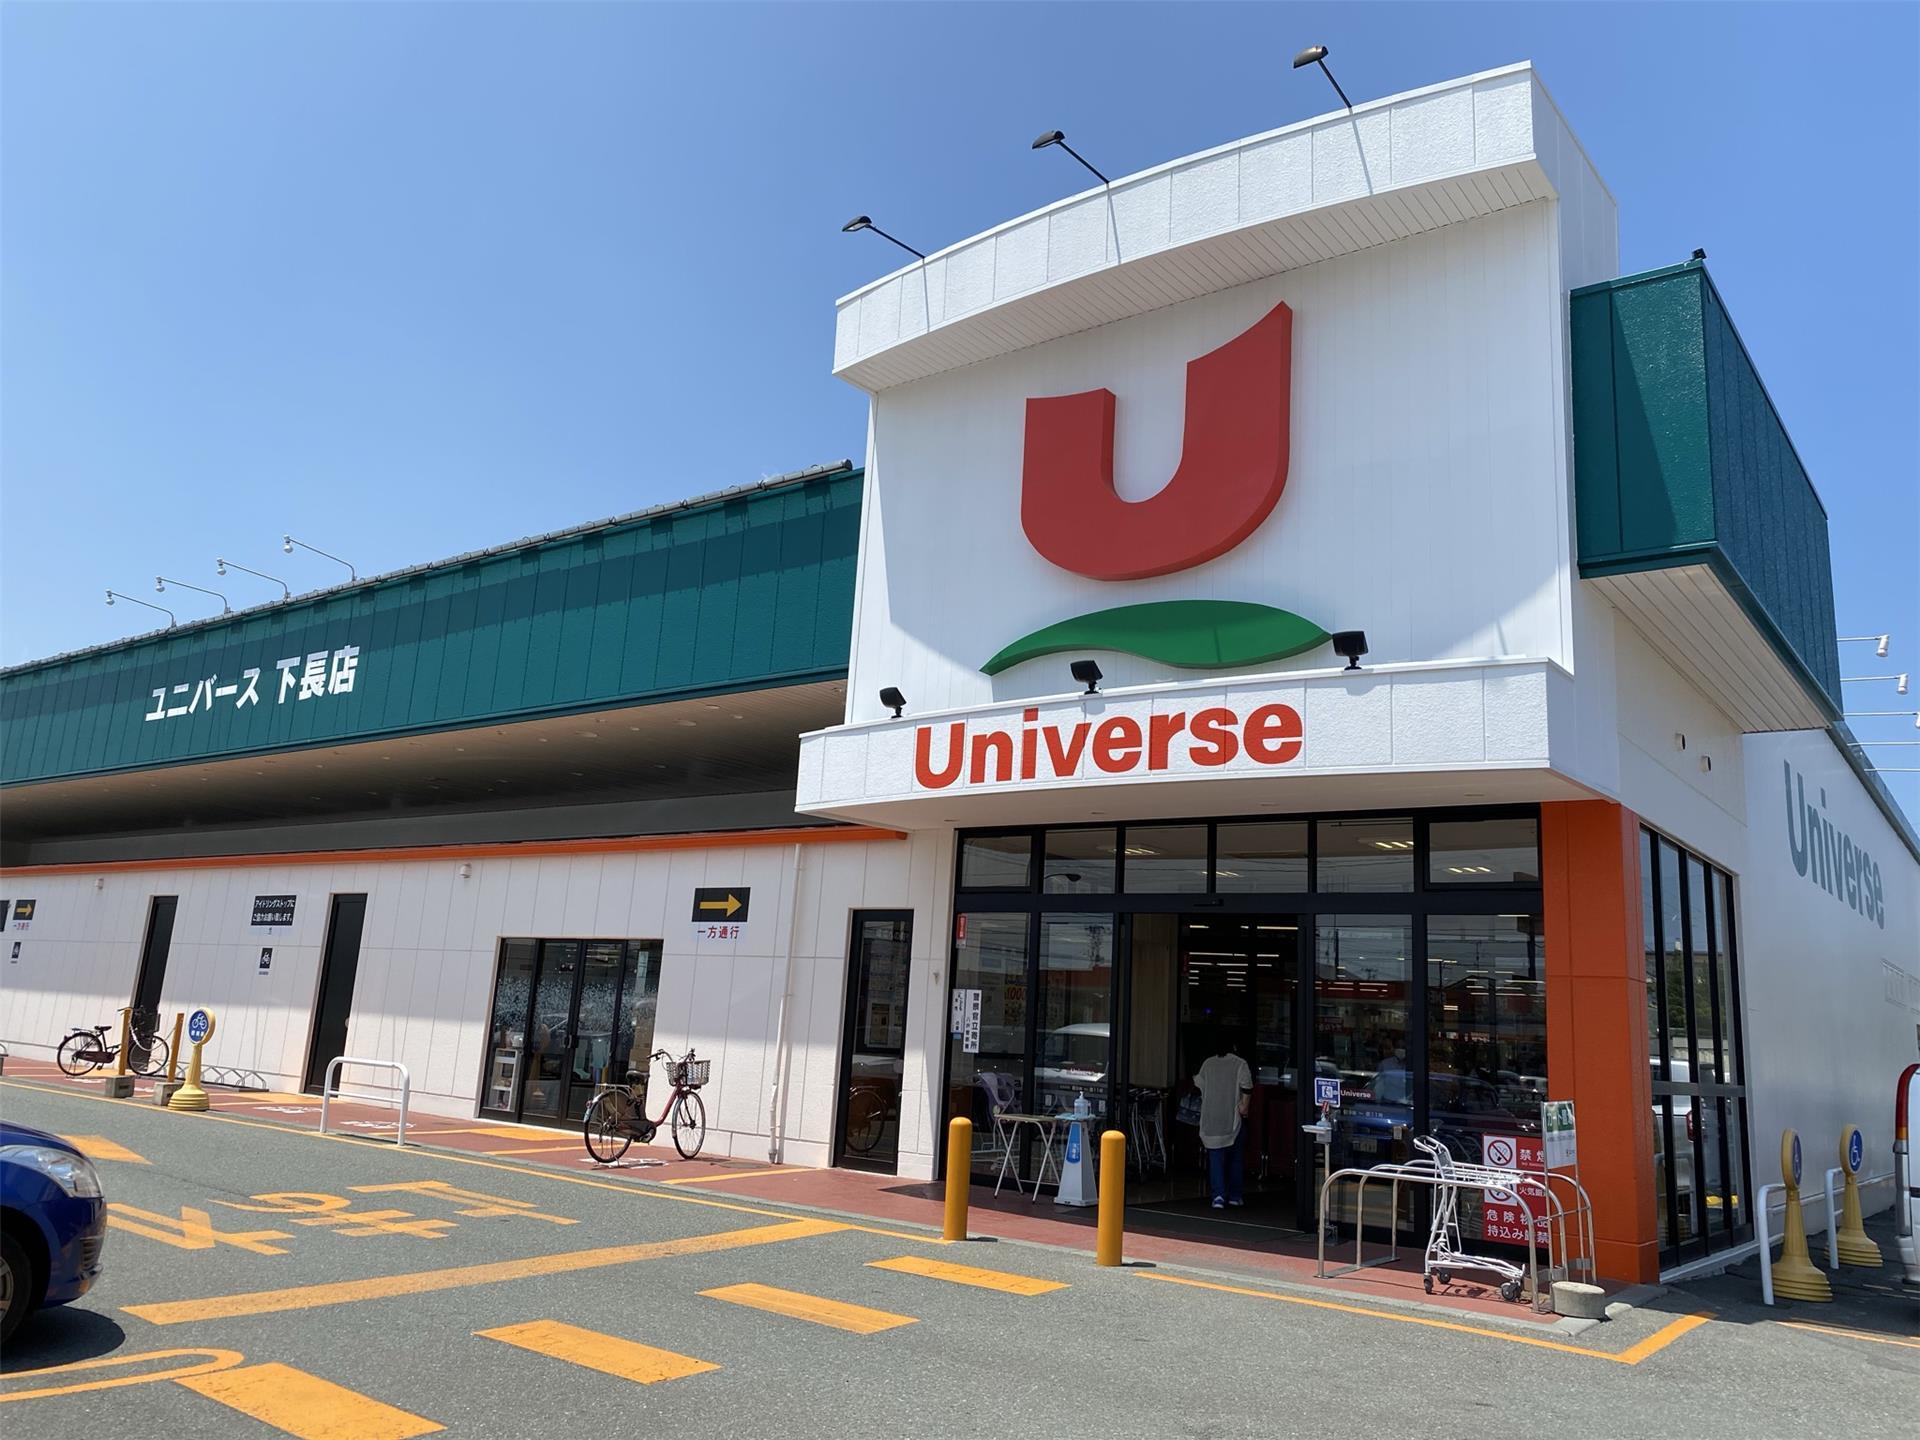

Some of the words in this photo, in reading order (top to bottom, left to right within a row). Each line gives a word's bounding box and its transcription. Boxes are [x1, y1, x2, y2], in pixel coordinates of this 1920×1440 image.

[145, 667, 260, 722] ユニバース
[276, 645, 360, 705] 下長店
[915, 703, 1302, 789] Universe
[1784, 759, 1884, 930] Universe
[254, 900, 295, 908] アイドリングストップに
[697, 925, 740, 939] 一方通行
[1340, 1090, 1371, 1099] Universe
[107, 1180, 581, 1255] 止まれ
